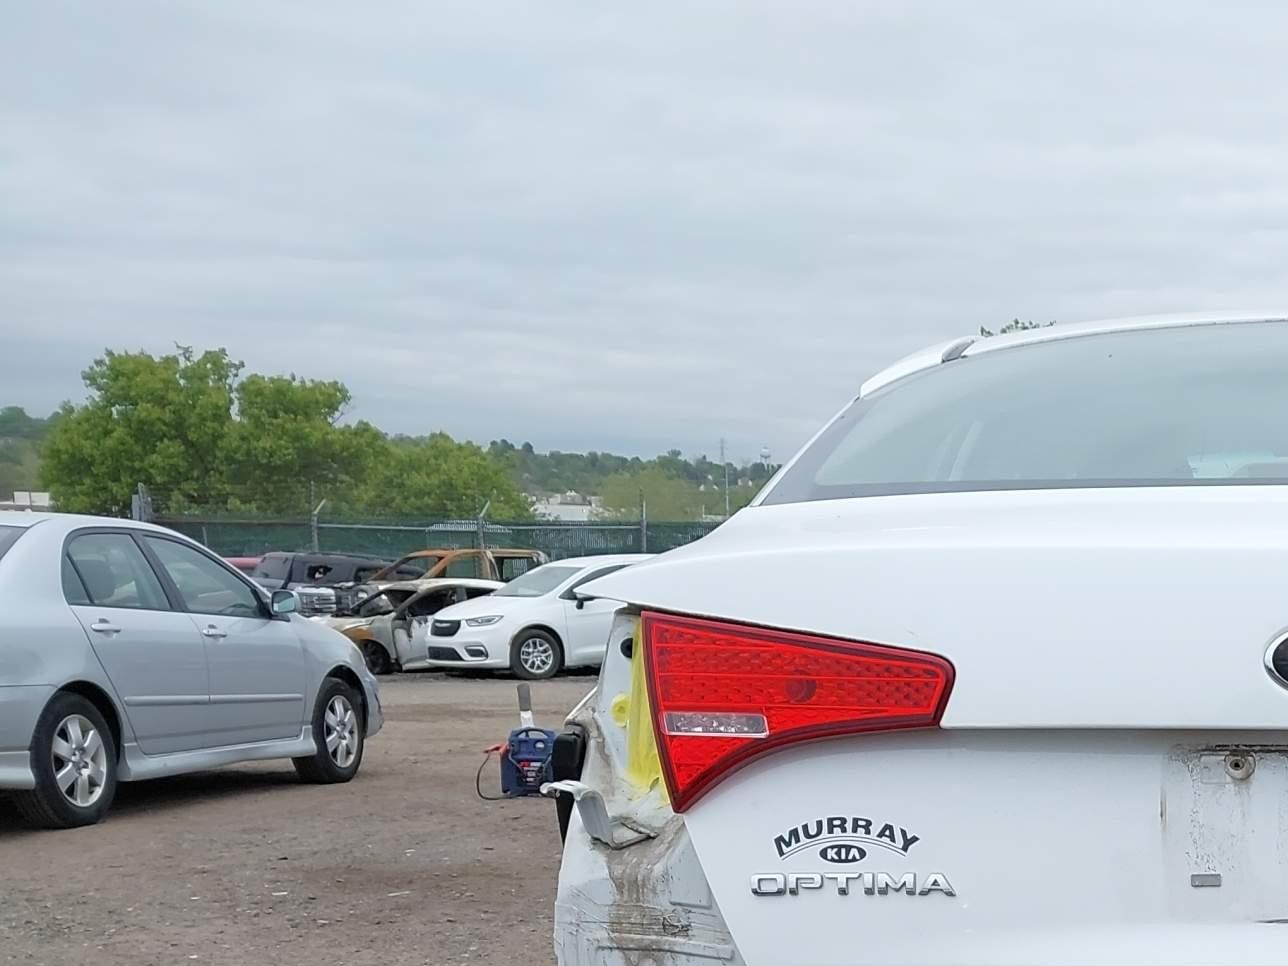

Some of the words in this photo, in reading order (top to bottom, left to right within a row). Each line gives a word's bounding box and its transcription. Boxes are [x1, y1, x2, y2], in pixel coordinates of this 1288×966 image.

[774, 816, 920, 858] MURRAY
[826, 848, 861, 861] KIA
[750, 872, 957, 897] OPTIMA
